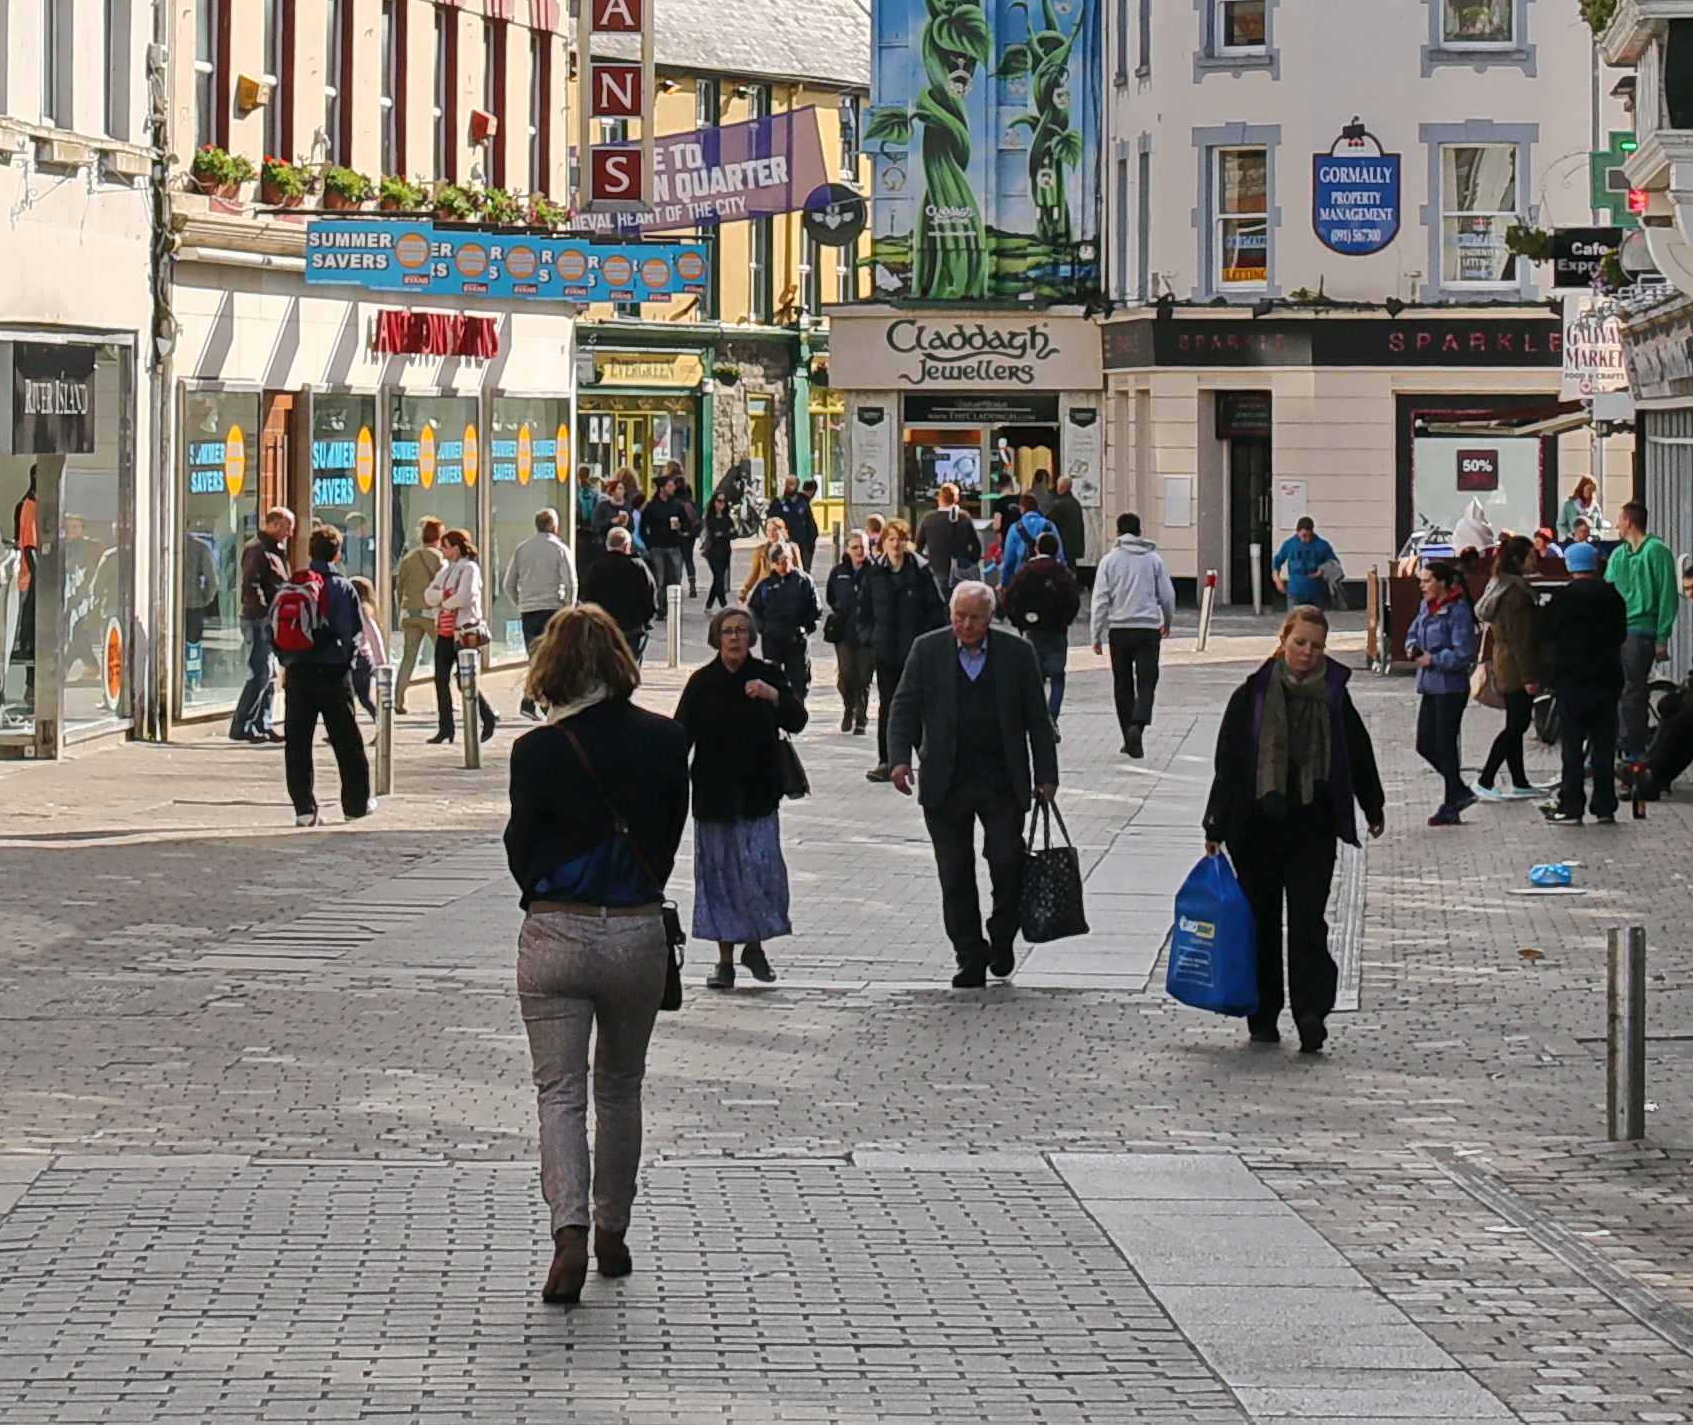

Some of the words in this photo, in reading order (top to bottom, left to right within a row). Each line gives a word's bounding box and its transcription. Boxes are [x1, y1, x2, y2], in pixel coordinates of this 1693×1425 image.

[669, 143, 704, 170] TO
[675, 155, 789, 203] QUARTER
[1319, 166, 1393, 184] GORMALLY
[1330, 191, 1382, 205] PROPERTY
[572, 213, 614, 231] DIEVAL
[617, 209, 661, 227] HEART
[665, 205, 682, 223] OF
[686, 202, 712, 220] THE
[716, 196, 746, 216] CITY
[1319, 207, 1394, 221] MANAGEMENT
[308, 232, 393, 249] SUMMER
[1571, 241, 1608, 256] Cafe
[311, 253, 389, 269] SAVERS
[1558, 258, 1602, 274] Expr
[886, 319, 1060, 362] Claddagh
[1389, 331, 1562, 353] SPARKLE
[1567, 347, 1624, 371] MARKET
[898, 359, 1035, 385] Jewellers
[1564, 372, 1586, 380] FOOD
[1597, 372, 1625, 381] CRAFTS
[24, 378, 54, 414] RIVER
[55, 378, 88, 414] ISLAND
[312, 440, 356, 470] SUMMER
[1462, 459, 1494, 473] 50%
[190, 470, 225, 493] SAVERS
[313, 477, 355, 505] SAVERS
